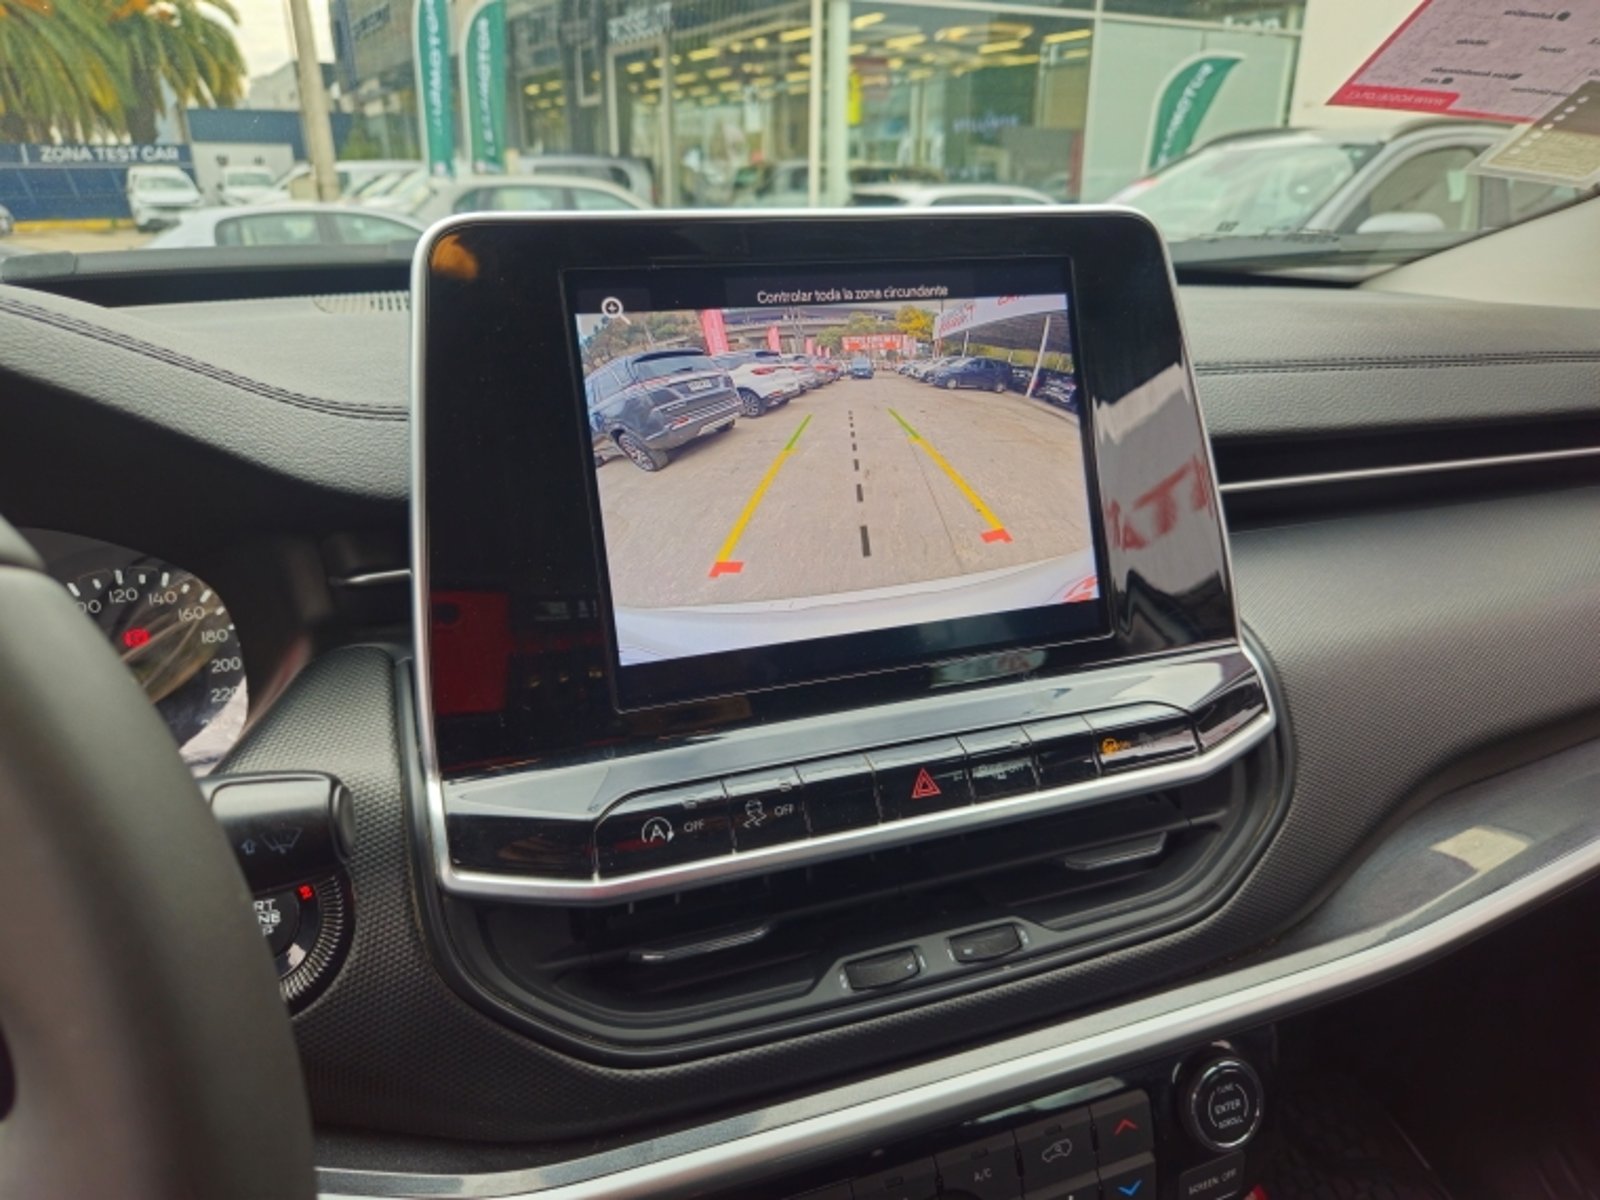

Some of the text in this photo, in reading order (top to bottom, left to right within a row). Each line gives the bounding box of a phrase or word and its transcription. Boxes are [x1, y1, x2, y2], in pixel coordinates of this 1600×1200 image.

[40, 145, 180, 164] ZONA TEST CAR
[757, 283, 949, 304] Controlar toda la zona circundante
[108, 587, 139, 604] 120
[148, 590, 178, 605] 140
[178, 605, 206, 623] 160
[201, 628, 229, 644] 180
[211, 656, 242, 674] 200
[774, 803, 796, 817] OFF
[683, 818, 705, 833] OFF
[1214, 1099, 1241, 1115] ENTER
[1188, 1168, 1237, 1195] SCREEN OFF
